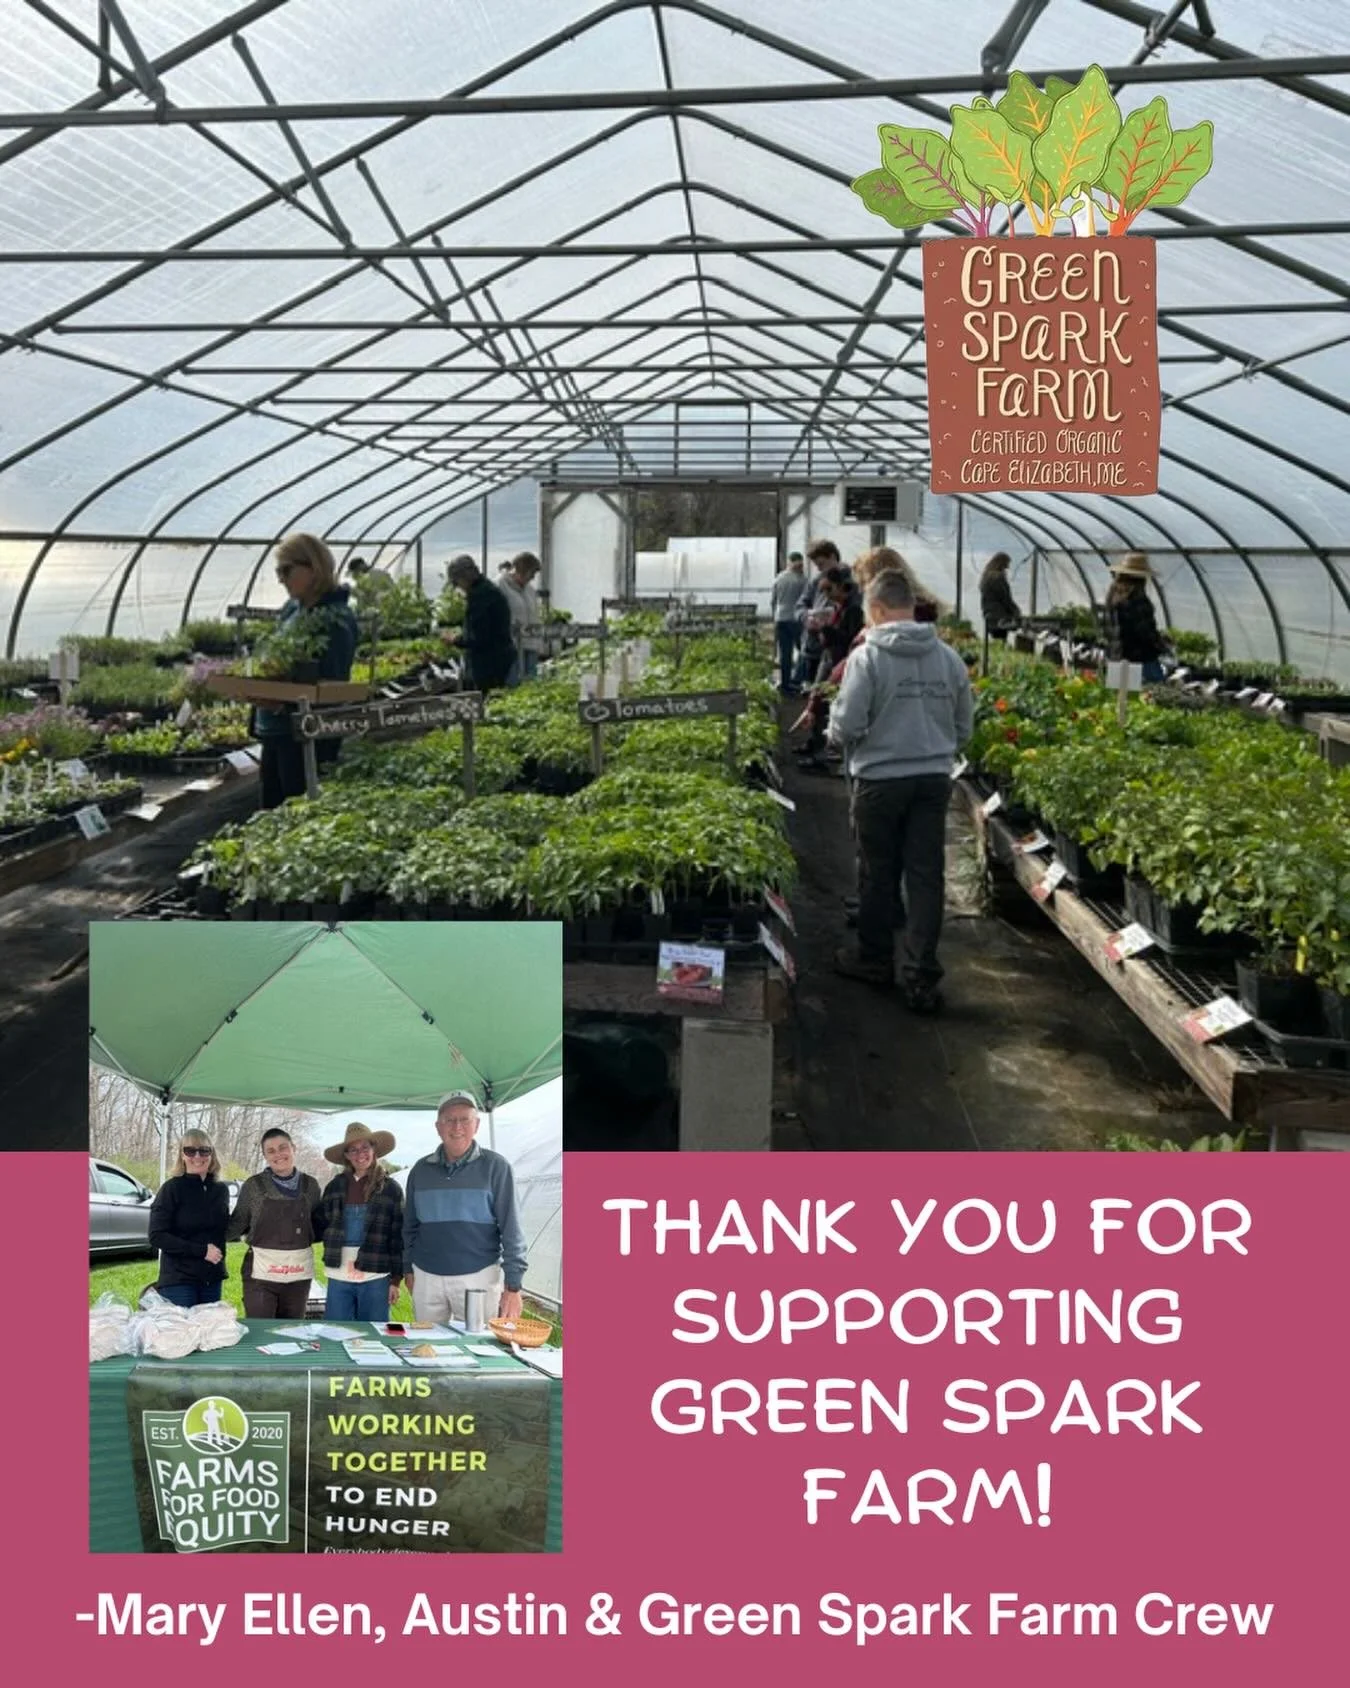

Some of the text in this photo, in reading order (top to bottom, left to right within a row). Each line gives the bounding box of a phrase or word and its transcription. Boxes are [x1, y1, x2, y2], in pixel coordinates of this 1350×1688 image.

[615, 697, 708, 718] Tomatoes
[302, 704, 457, 737] Cherry Tomatoes
[328, 1376, 432, 1397] FARMS
[151, 1426, 283, 1440] EST. 2020
[328, 1413, 475, 1435] WORKING
[328, 1451, 487, 1472] TOGETHER
[155, 1456, 279, 1491] FARMS
[160, 1487, 280, 1516] FOR FOOD
[326, 1486, 437, 1508] TO END
[164, 1510, 280, 1548] EQUITY
[326, 1515, 450, 1537] HUNGER
